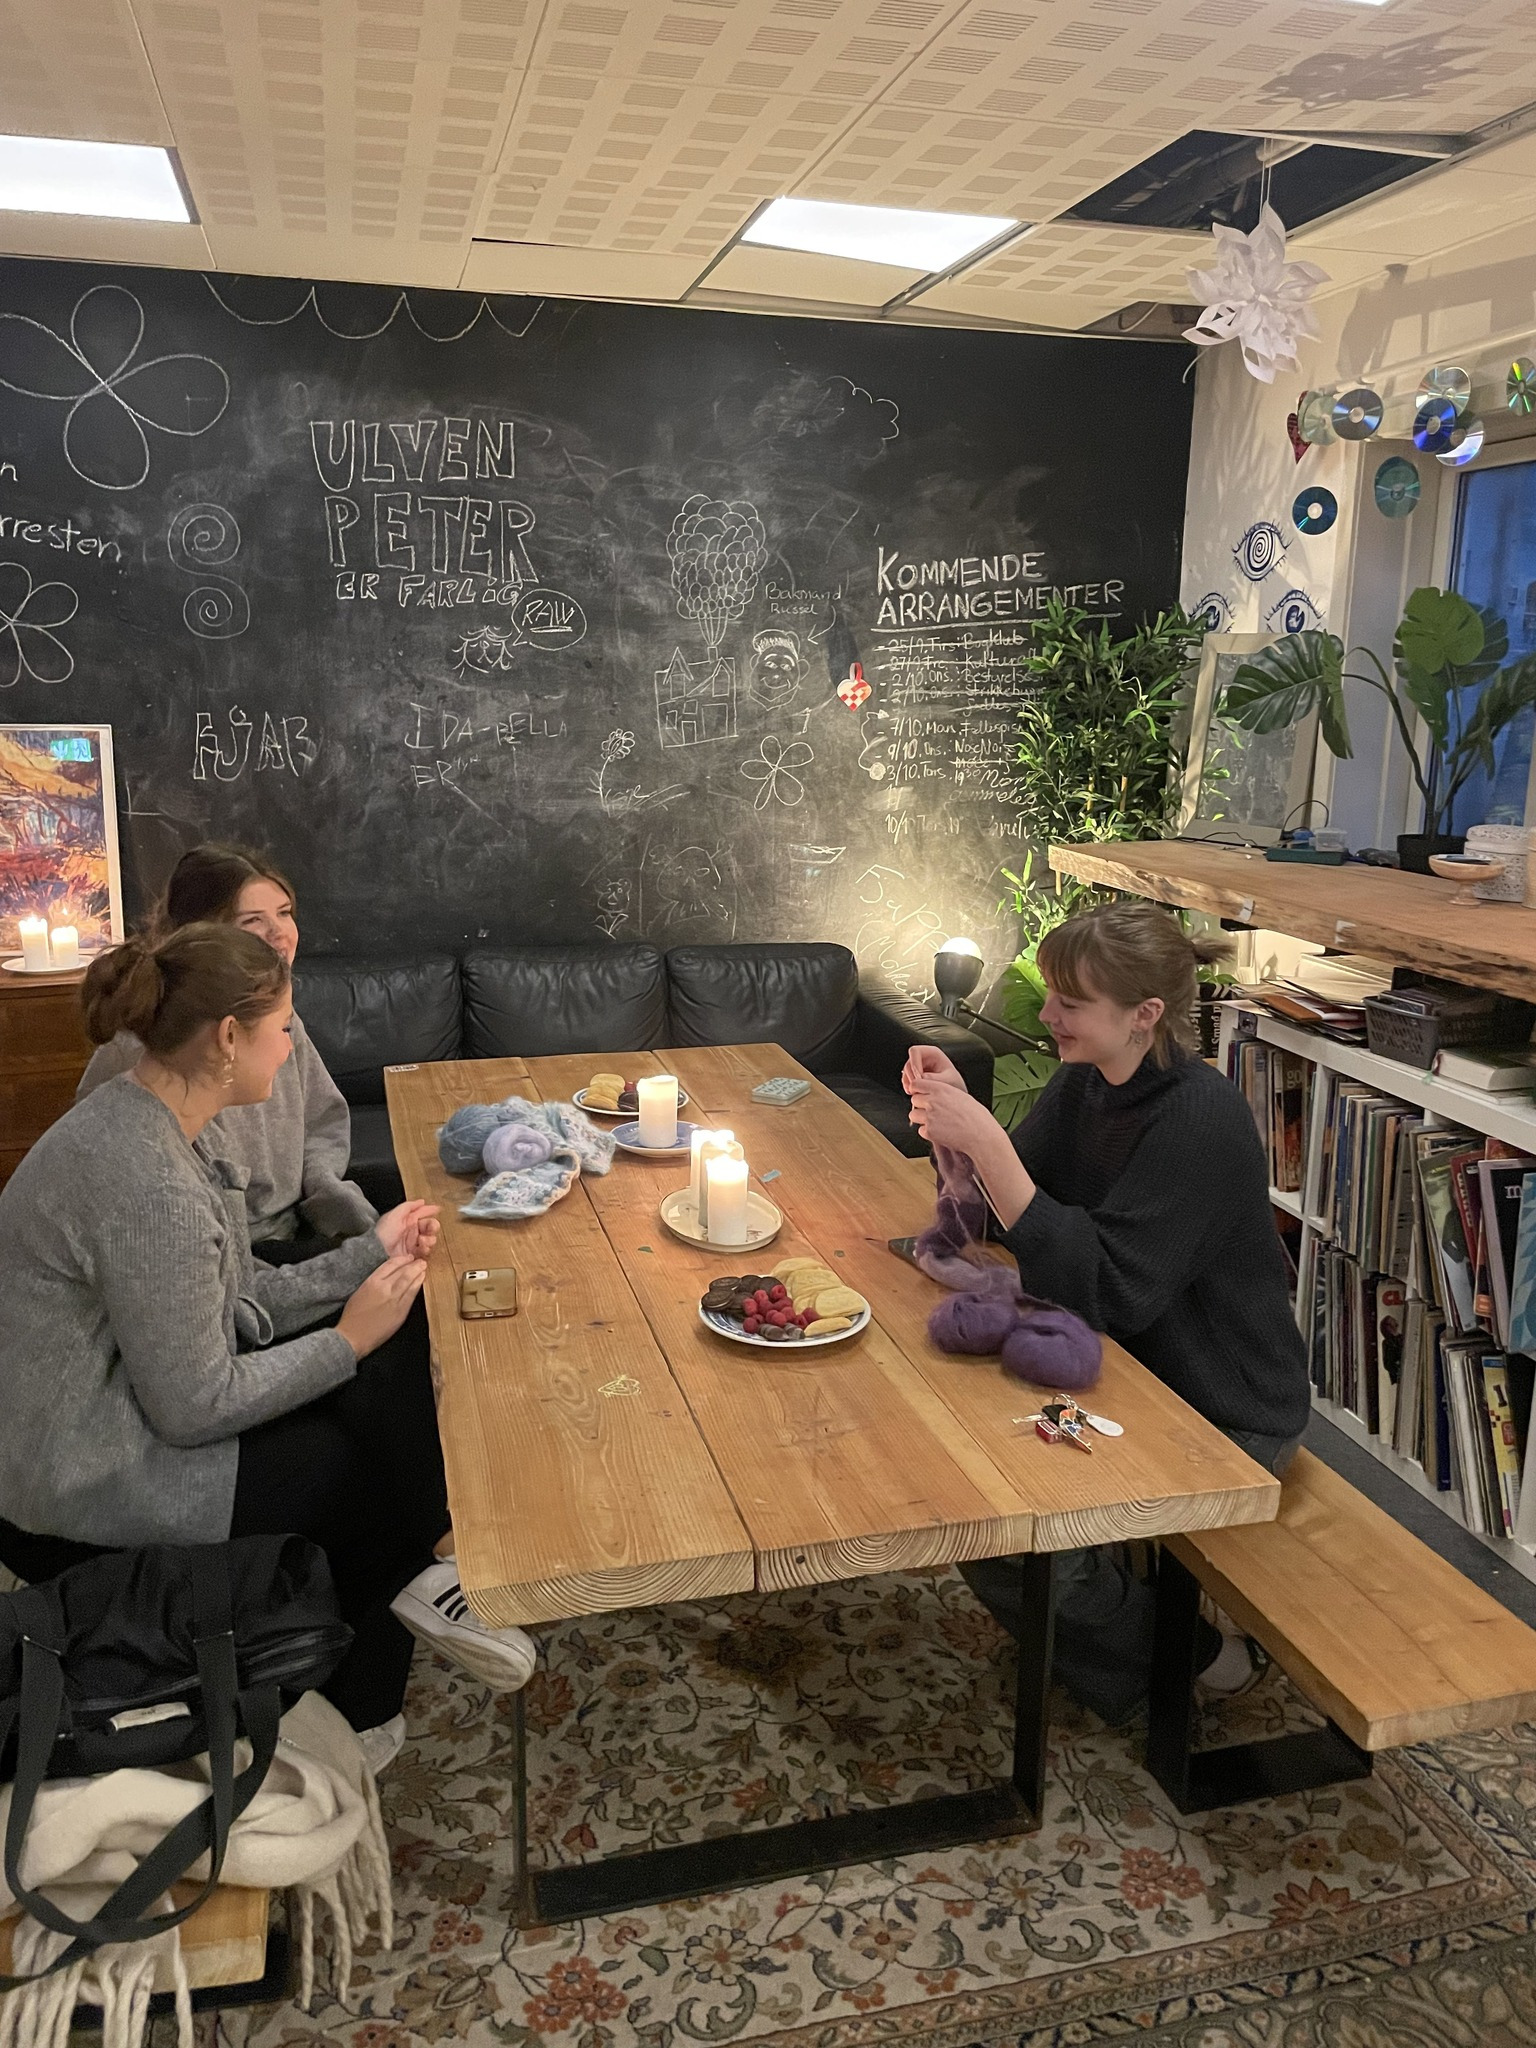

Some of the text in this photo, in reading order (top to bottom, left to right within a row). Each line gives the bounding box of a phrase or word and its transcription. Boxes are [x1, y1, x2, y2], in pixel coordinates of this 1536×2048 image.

[309, 416, 515, 492] ULVEN
[324, 491, 539, 584] PETER
[336, 571, 380, 599] ER
[877, 546, 1046, 596] KOMMENDE
[522, 600, 574, 627] RAW
[876, 579, 1125, 626] ARRANGEMENTER
